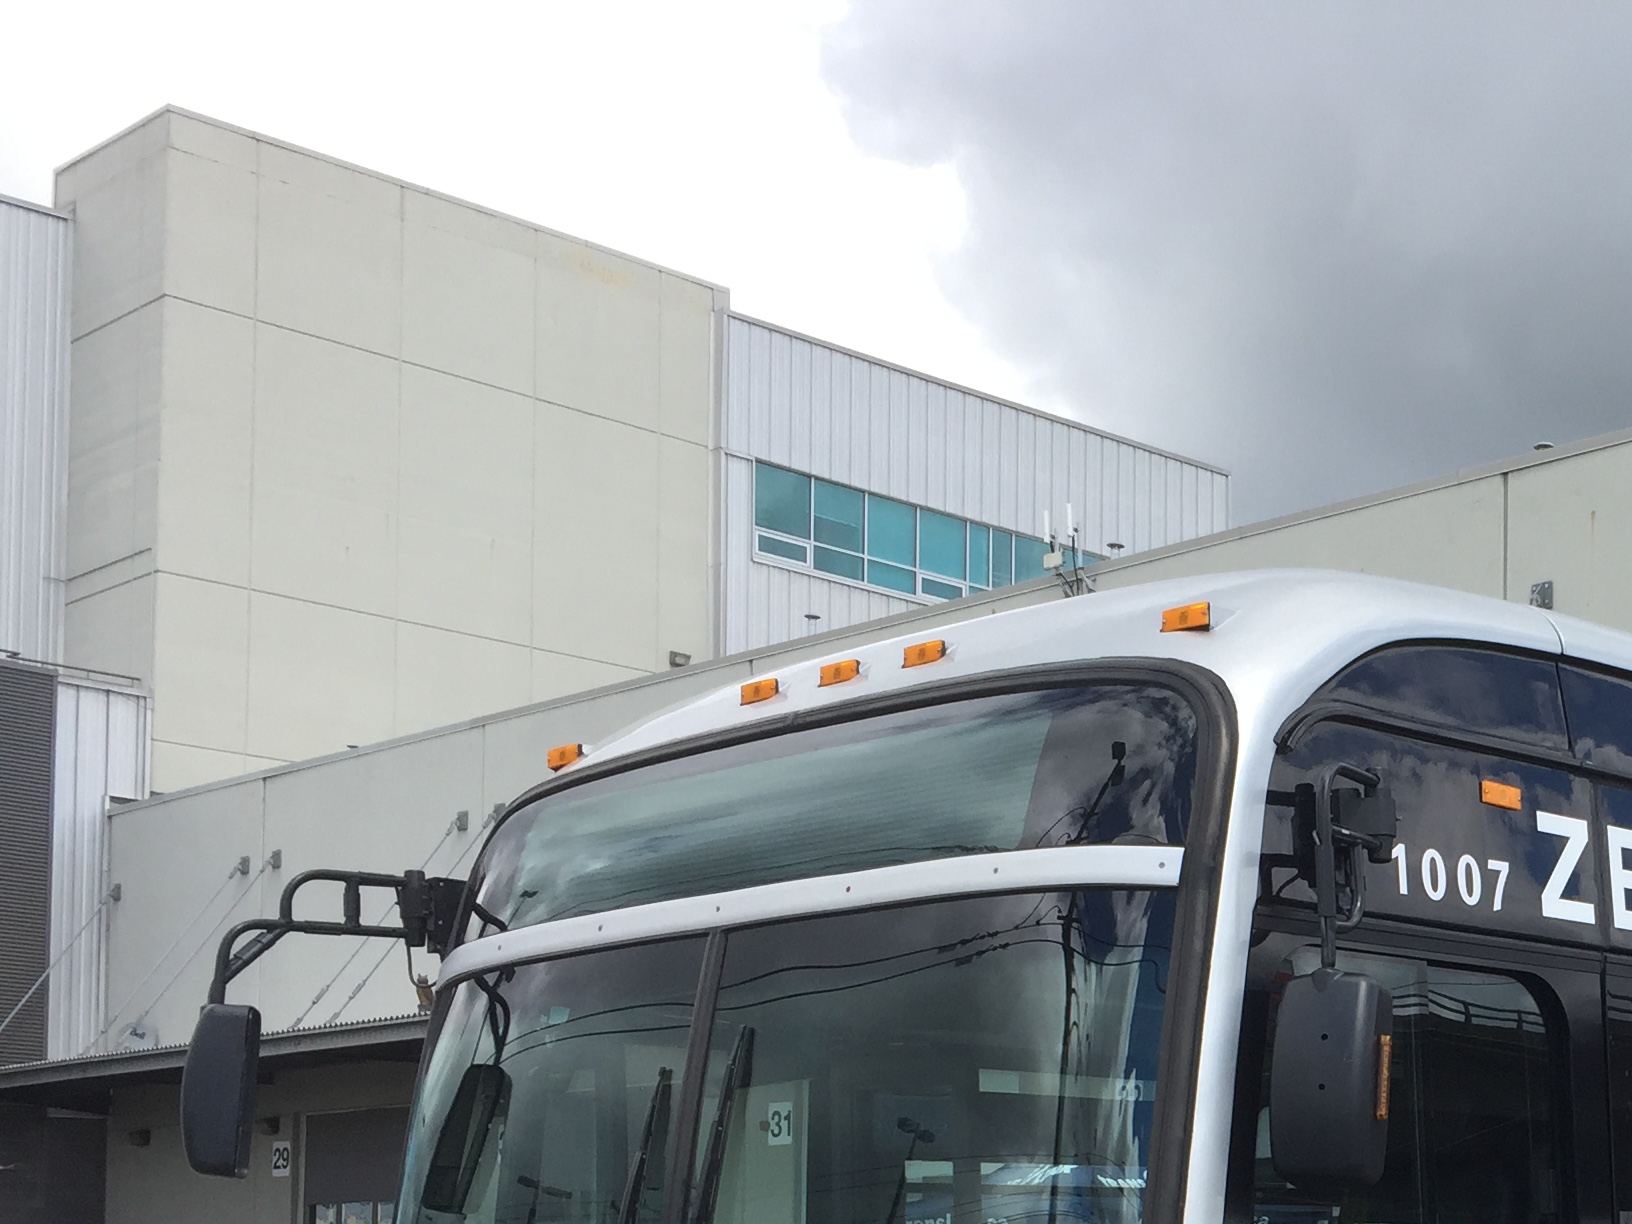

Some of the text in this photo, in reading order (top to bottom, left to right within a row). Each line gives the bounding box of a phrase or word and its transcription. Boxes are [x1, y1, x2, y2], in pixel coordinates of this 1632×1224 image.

[1391, 843, 1510, 912] 1007
[770, 1110, 792, 1138] 31
[273, 1147, 290, 1169] 29
